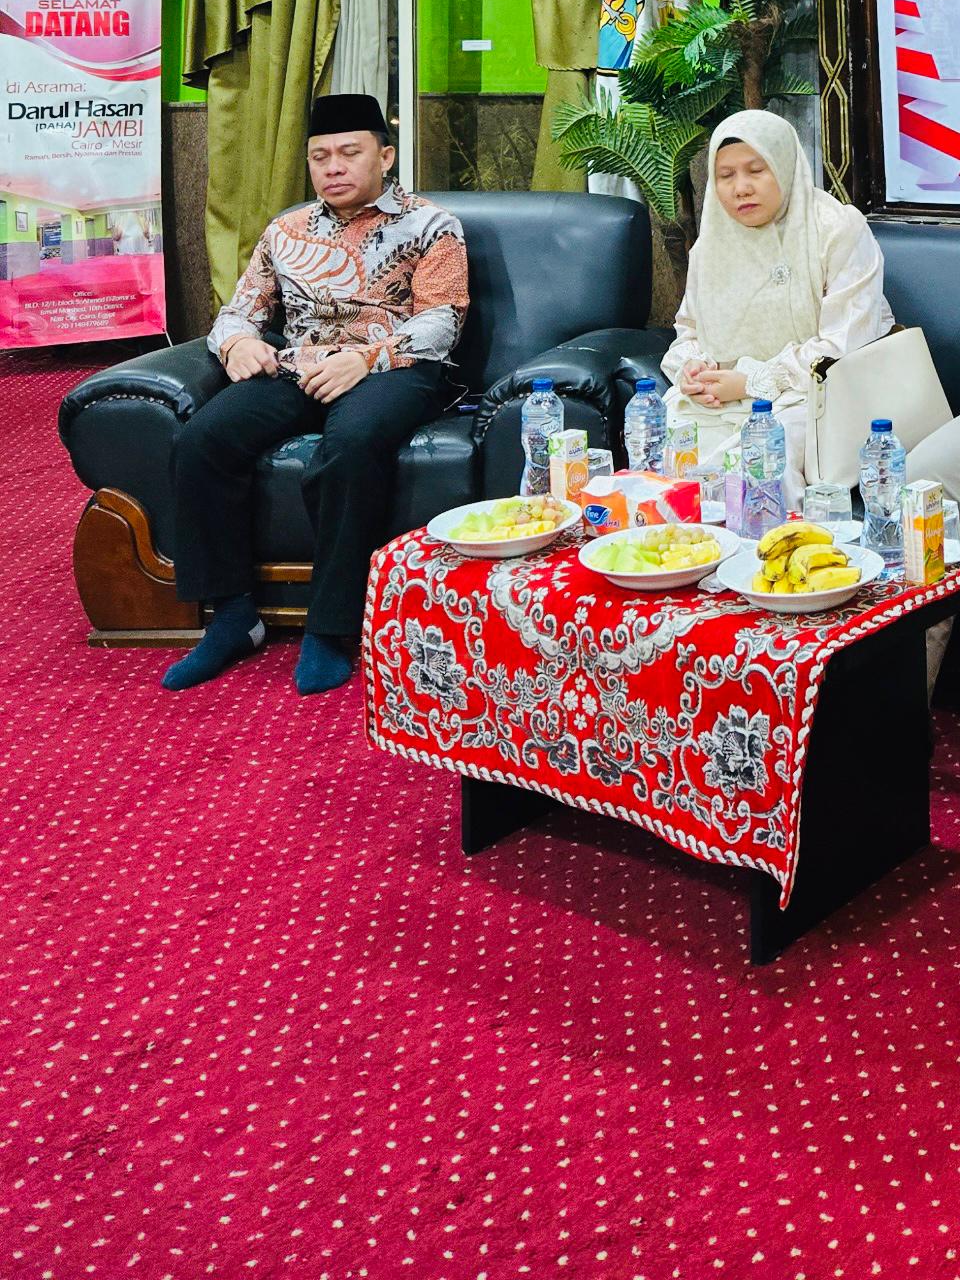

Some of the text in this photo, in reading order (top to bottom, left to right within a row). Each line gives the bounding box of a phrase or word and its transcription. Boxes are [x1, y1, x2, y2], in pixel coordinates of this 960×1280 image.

[38, 0, 121, 10] SELAMAT
[24, 10, 130, 38] DATANG
[6, 80, 87, 94] di Asrama:
[8, 100, 144, 120] Darul Hasan
[72, 120, 144, 138] JAMBI
[71, 140, 103, 150] Cairo
[112, 139, 143, 150] Mesir
